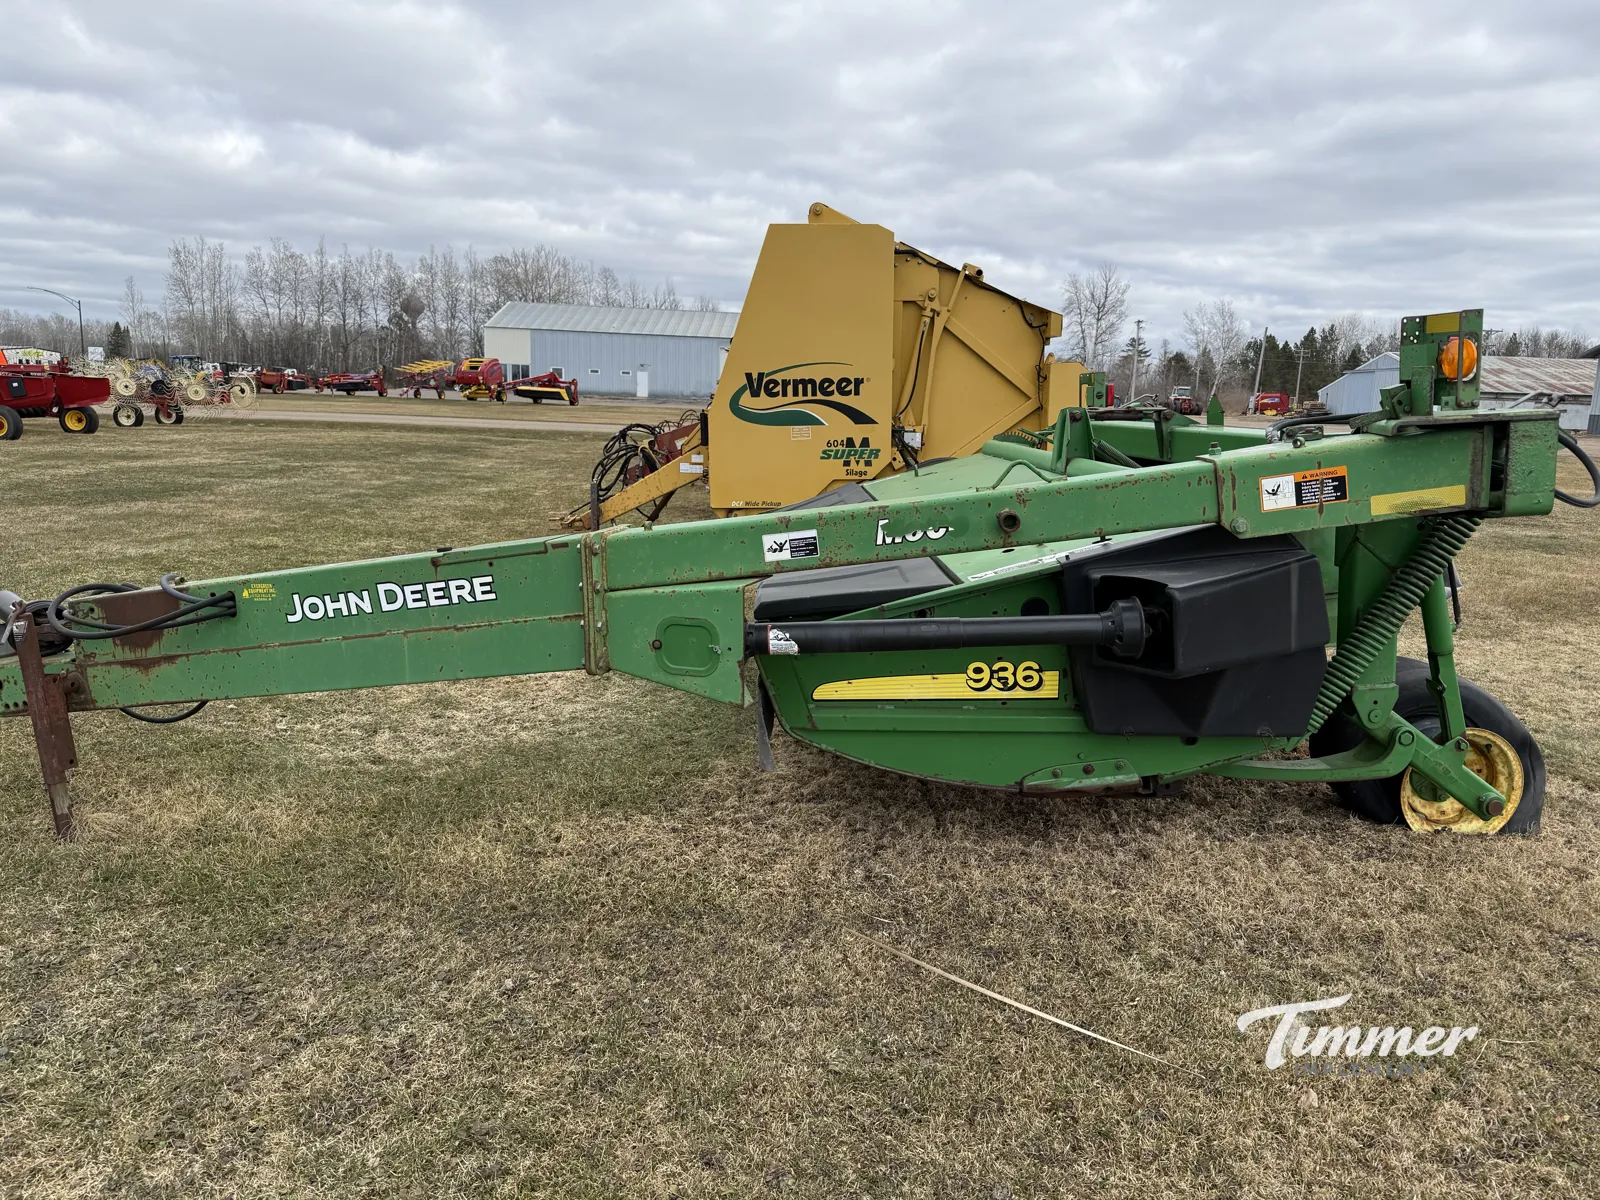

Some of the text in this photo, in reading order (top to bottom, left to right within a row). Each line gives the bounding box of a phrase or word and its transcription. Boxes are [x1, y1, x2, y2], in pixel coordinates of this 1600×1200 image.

[745, 372, 864, 398] Vermeer
[826, 439, 845, 448] 604
[820, 448, 881, 460] SUPER
[845, 468, 868, 477] Silage
[761, 500, 782, 508] Pickup
[286, 575, 497, 623] JOHN DEERE
[966, 661, 1043, 692] 936
